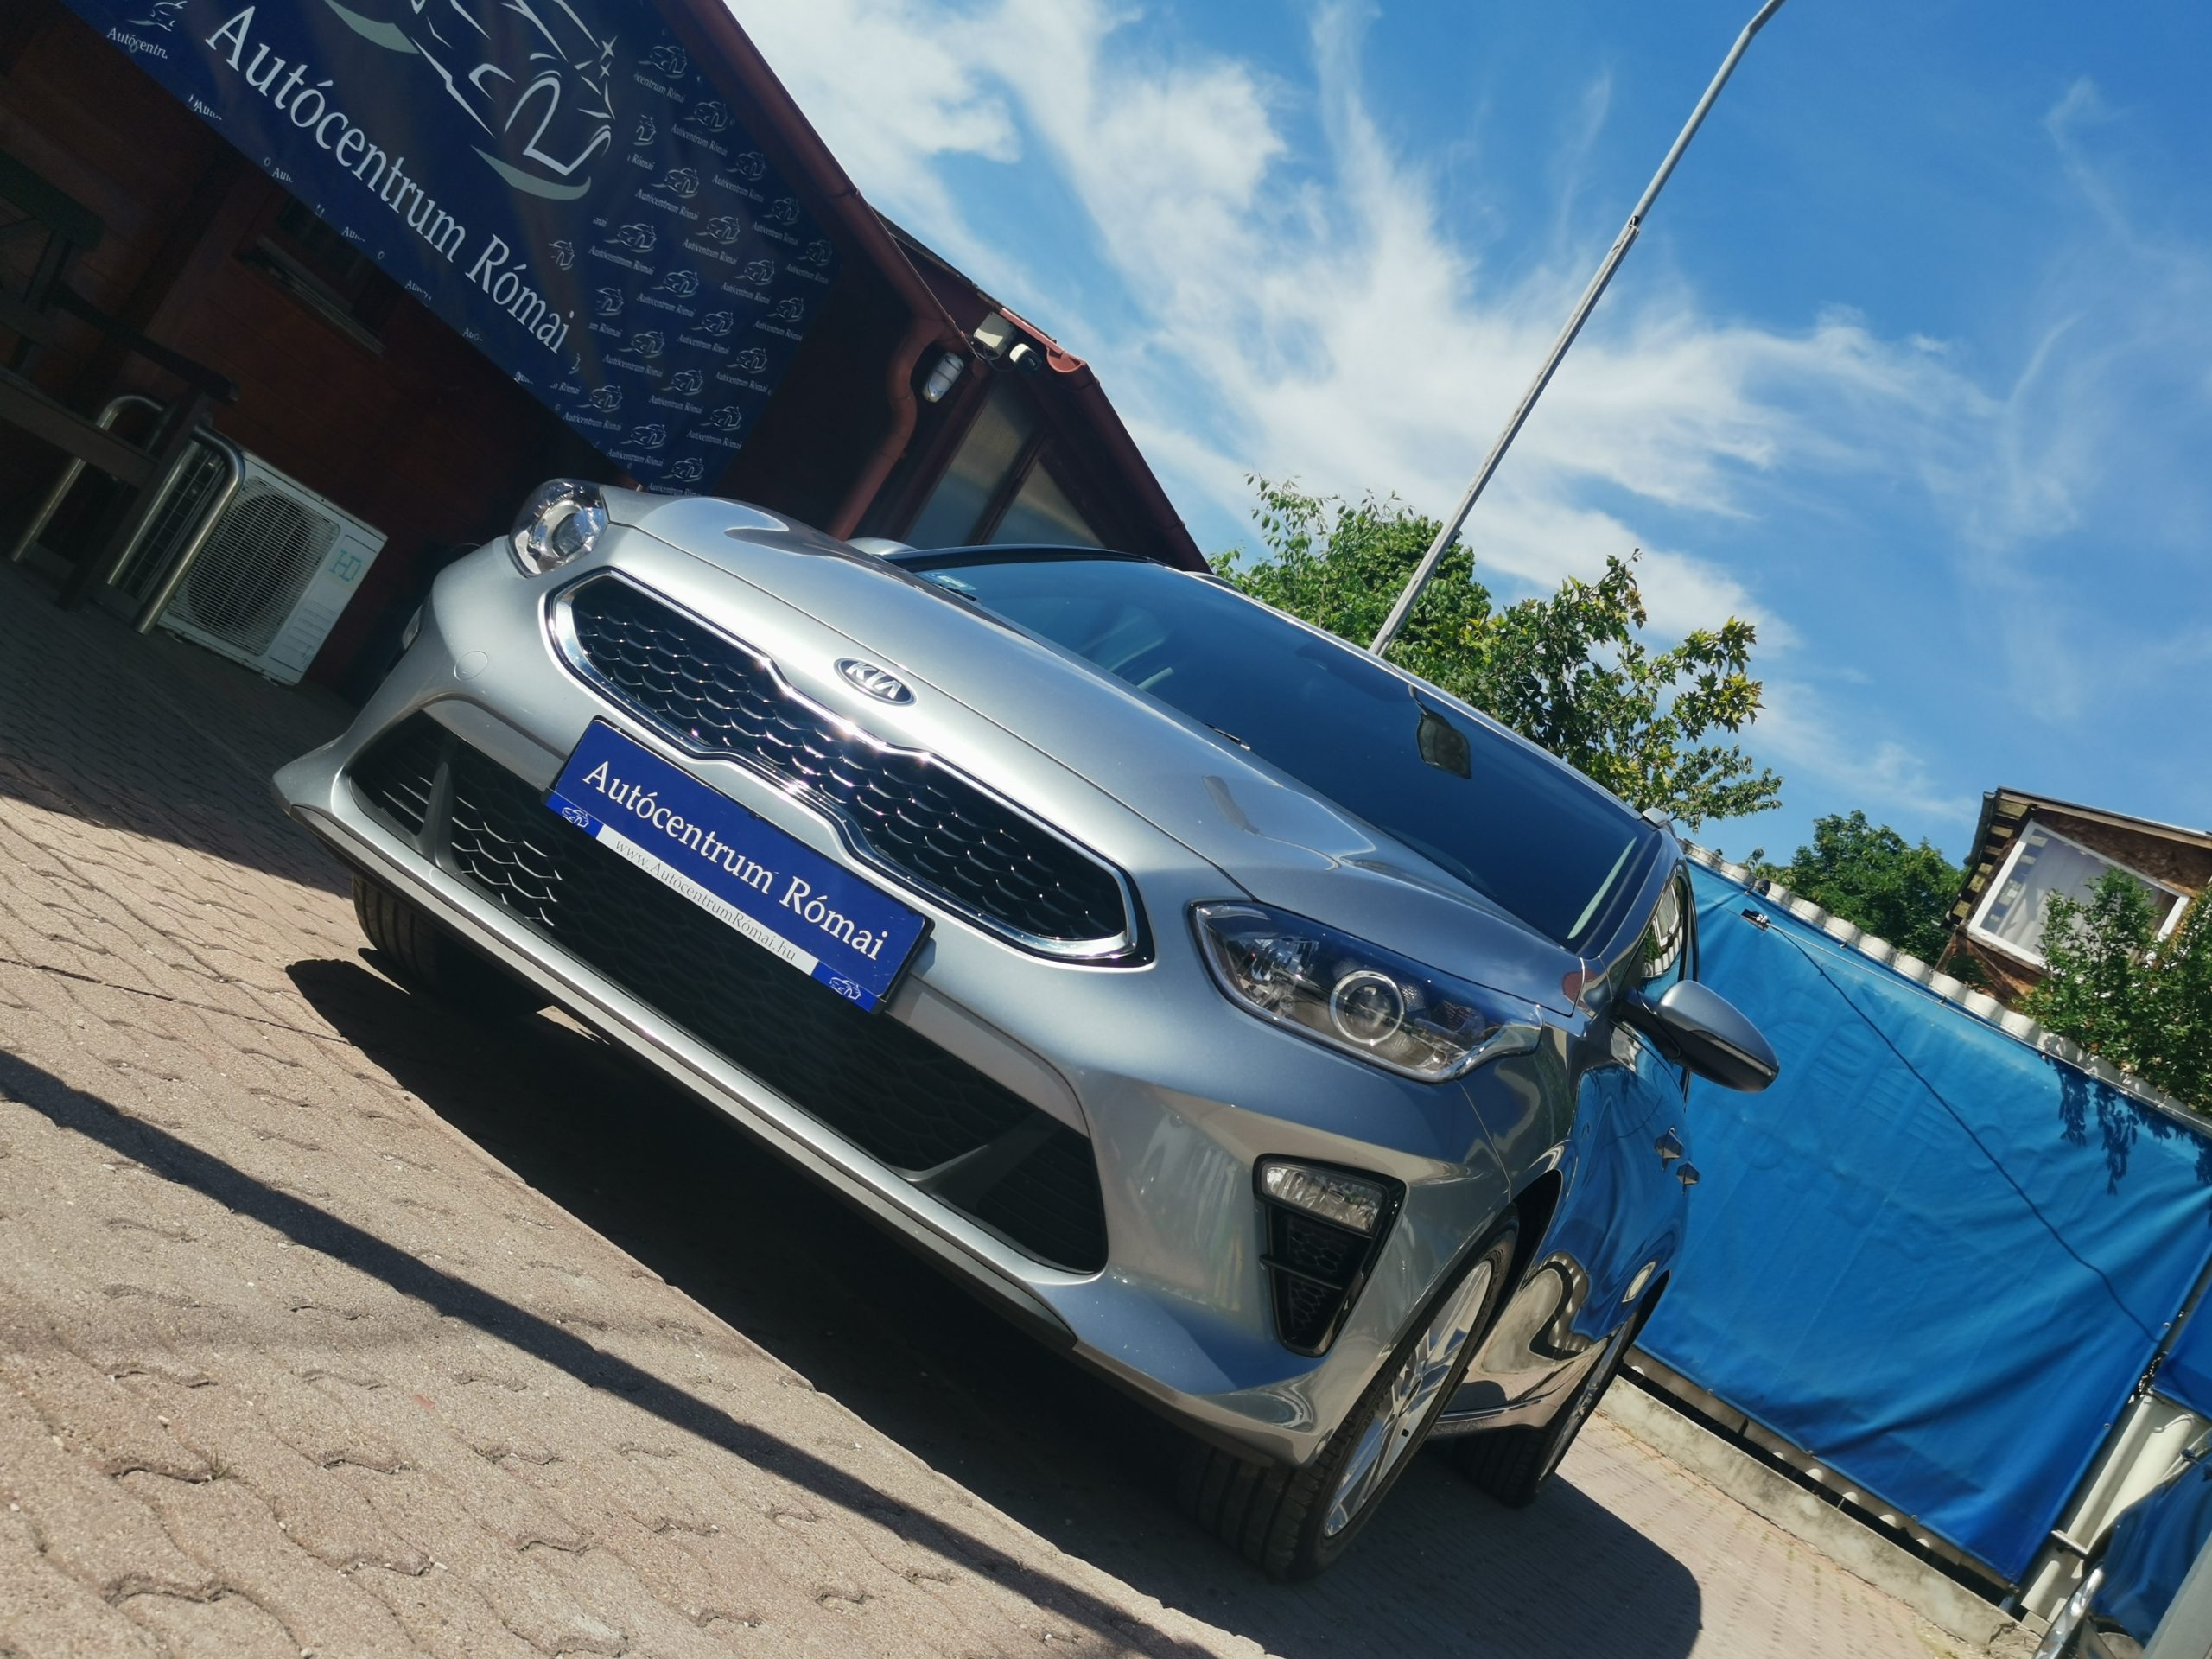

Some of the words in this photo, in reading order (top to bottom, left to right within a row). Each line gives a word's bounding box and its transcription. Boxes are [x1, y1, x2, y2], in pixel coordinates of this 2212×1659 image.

[205, 5, 467, 263] Autócentrum
[465, 234, 575, 355] Római
[845, 661, 902, 700] KIA
[582, 760, 774, 895] Autócentrum
[779, 877, 889, 961] Római
[616, 838, 797, 963] www.AutócentrumRómai.hu
